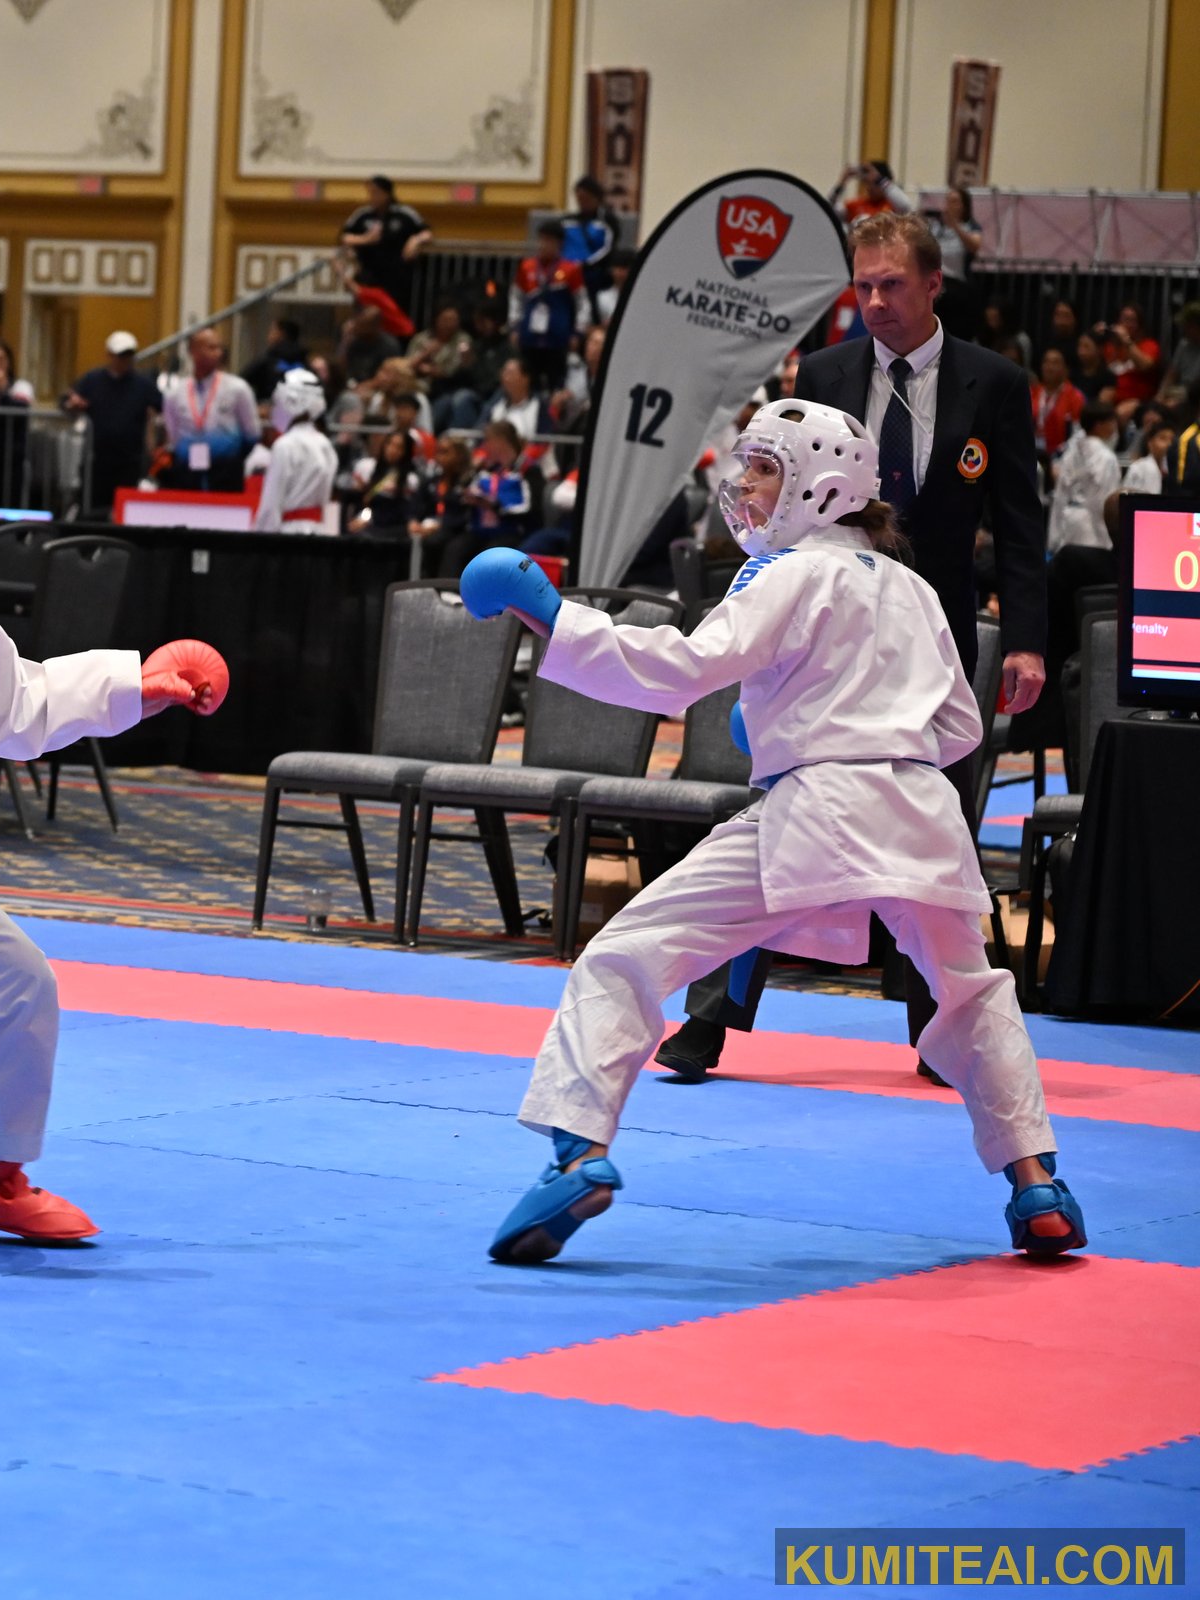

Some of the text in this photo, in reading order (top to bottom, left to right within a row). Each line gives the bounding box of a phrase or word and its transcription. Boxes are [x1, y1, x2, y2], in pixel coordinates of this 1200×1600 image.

[725, 203, 777, 240] USA
[665, 285, 792, 333] KARATE-DO
[695, 277, 769, 309] NATIONAL
[686, 312, 763, 342] FEDERATION
[624, 382, 674, 449] 12
[1174, 550, 1199, 591] 0
